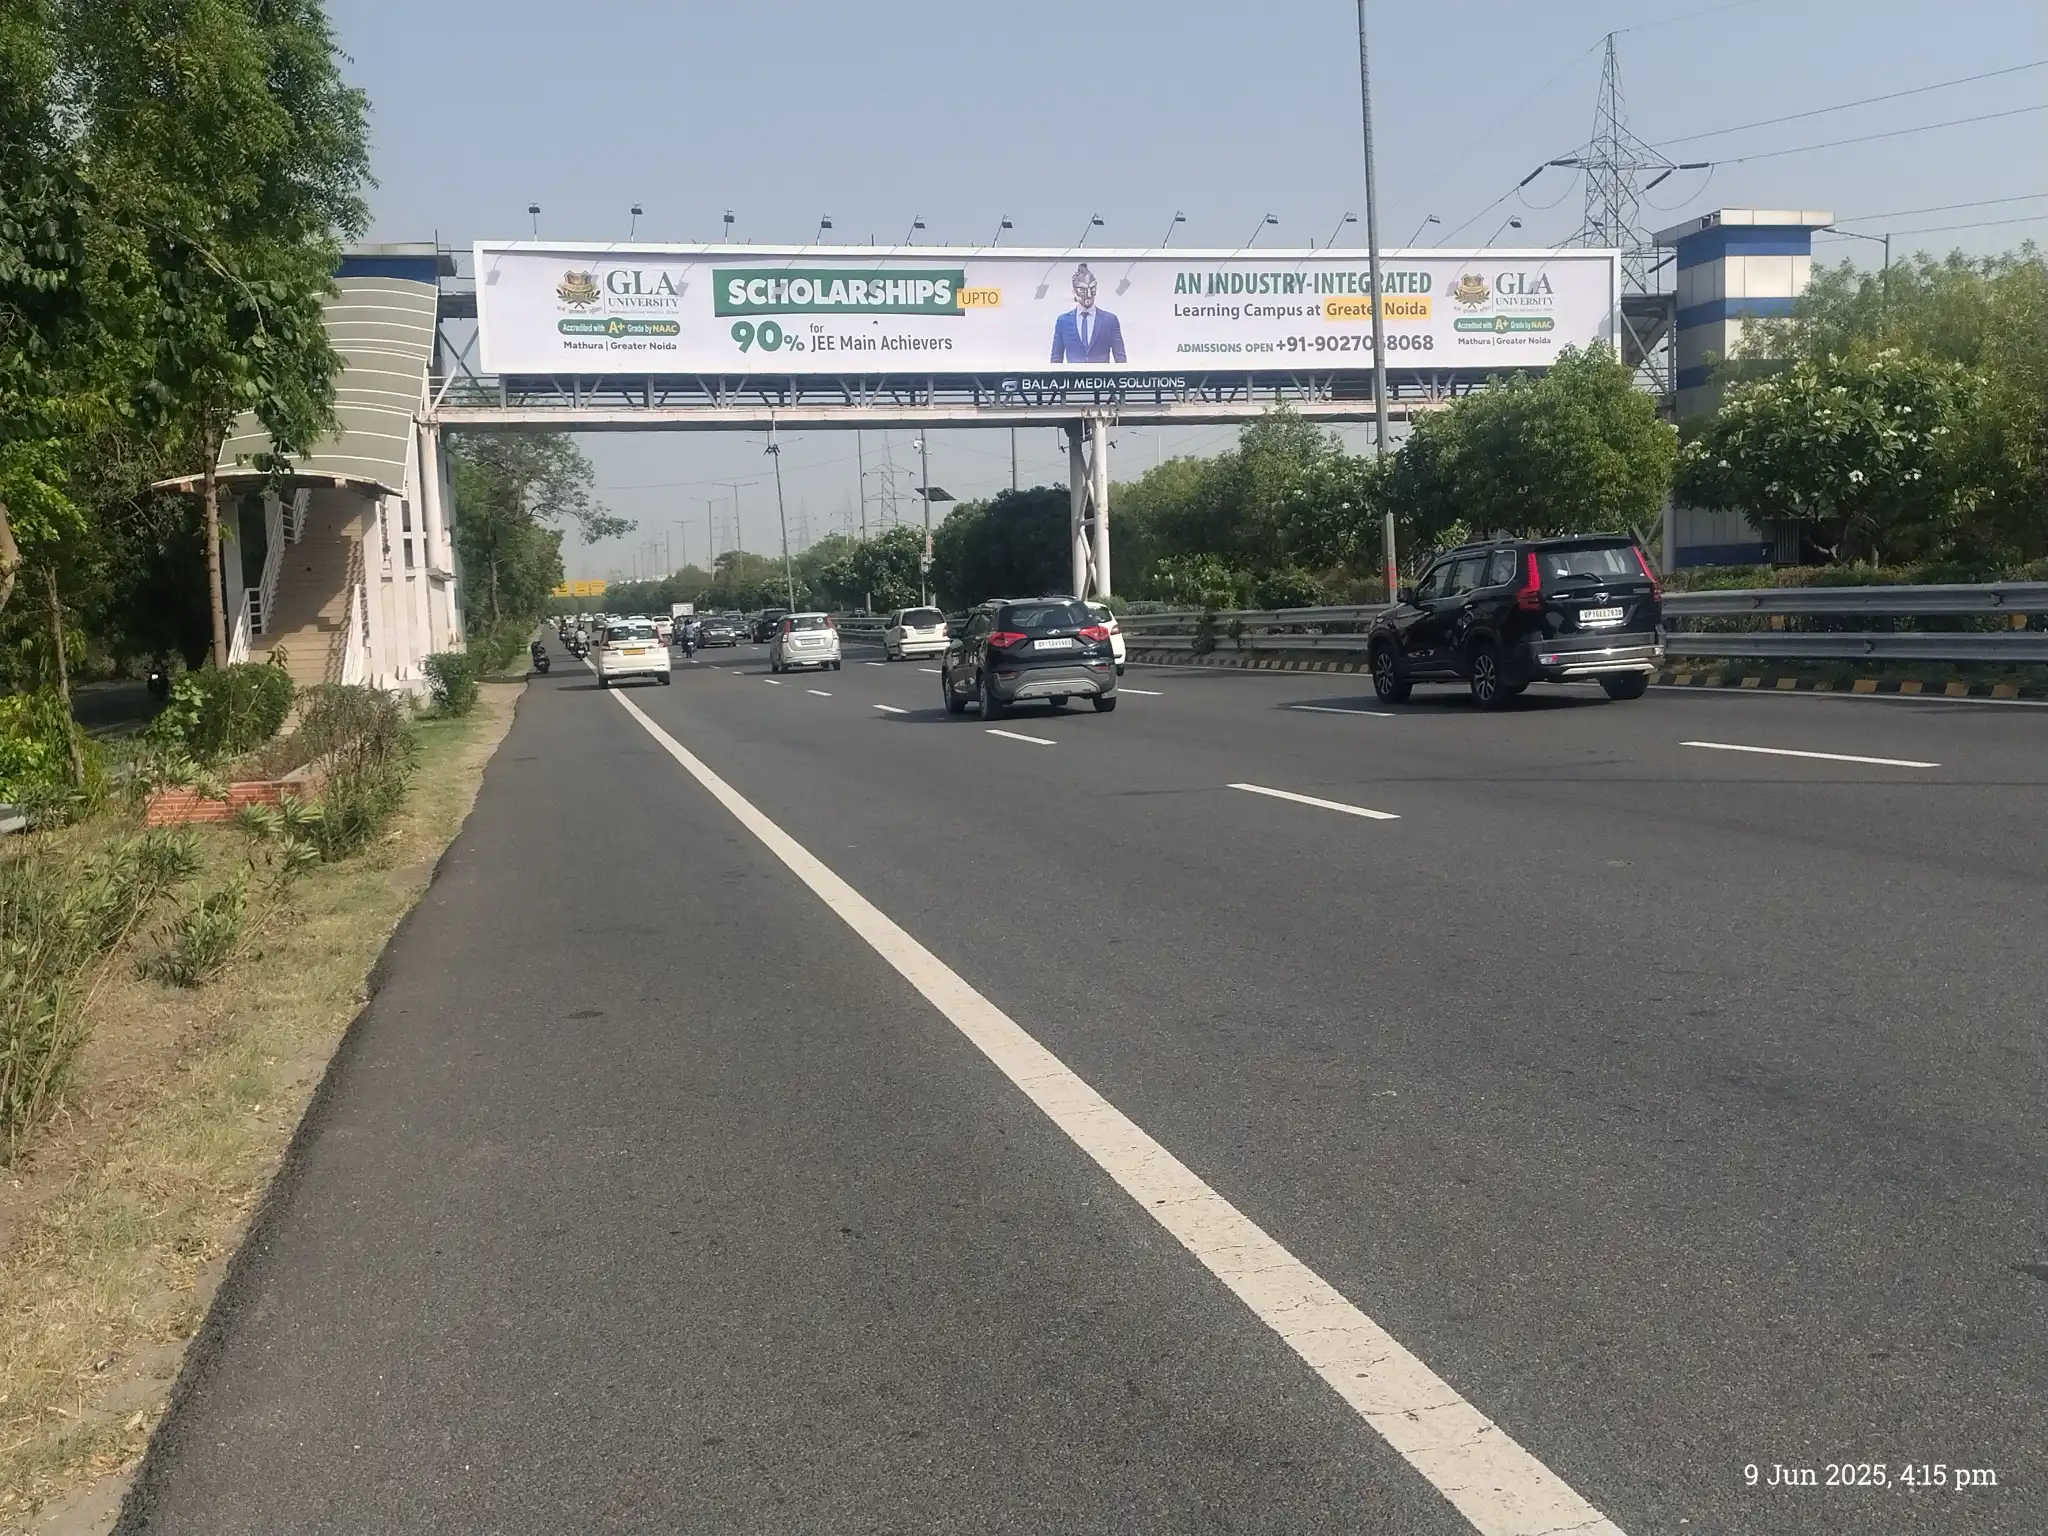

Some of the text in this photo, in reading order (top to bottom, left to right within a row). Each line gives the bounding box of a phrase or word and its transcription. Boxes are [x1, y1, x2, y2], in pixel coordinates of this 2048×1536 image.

[607, 270, 678, 295] GLA
[1174, 272, 1432, 294] AN INDUSTRY-INTEGATED
[1496, 272, 1554, 294] GLA
[728, 279, 998, 305] SCHOLARSHIPS UPTO
[608, 298, 679, 307] UNIVERSITY
[1496, 297, 1553, 305] UNIVERSITY
[1174, 302, 1427, 319] Learning Campus at Greate Noida
[563, 321, 677, 334] Accredited with A+ Grade by NAAC
[810, 323, 824, 333] for
[1496, 319, 1509, 330] A+
[731, 320, 805, 354] 90%
[811, 335, 953, 352] JEE Main Achievers
[1177, 335, 1434, 352] ADMISSIONS OPEN +91-902708068
[1528, 336, 1551, 344] Noida
[563, 341, 677, 350] Mathura Greater Noida
[1022, 377, 1186, 389] BALAJI MEDIA SOLUTIONS
